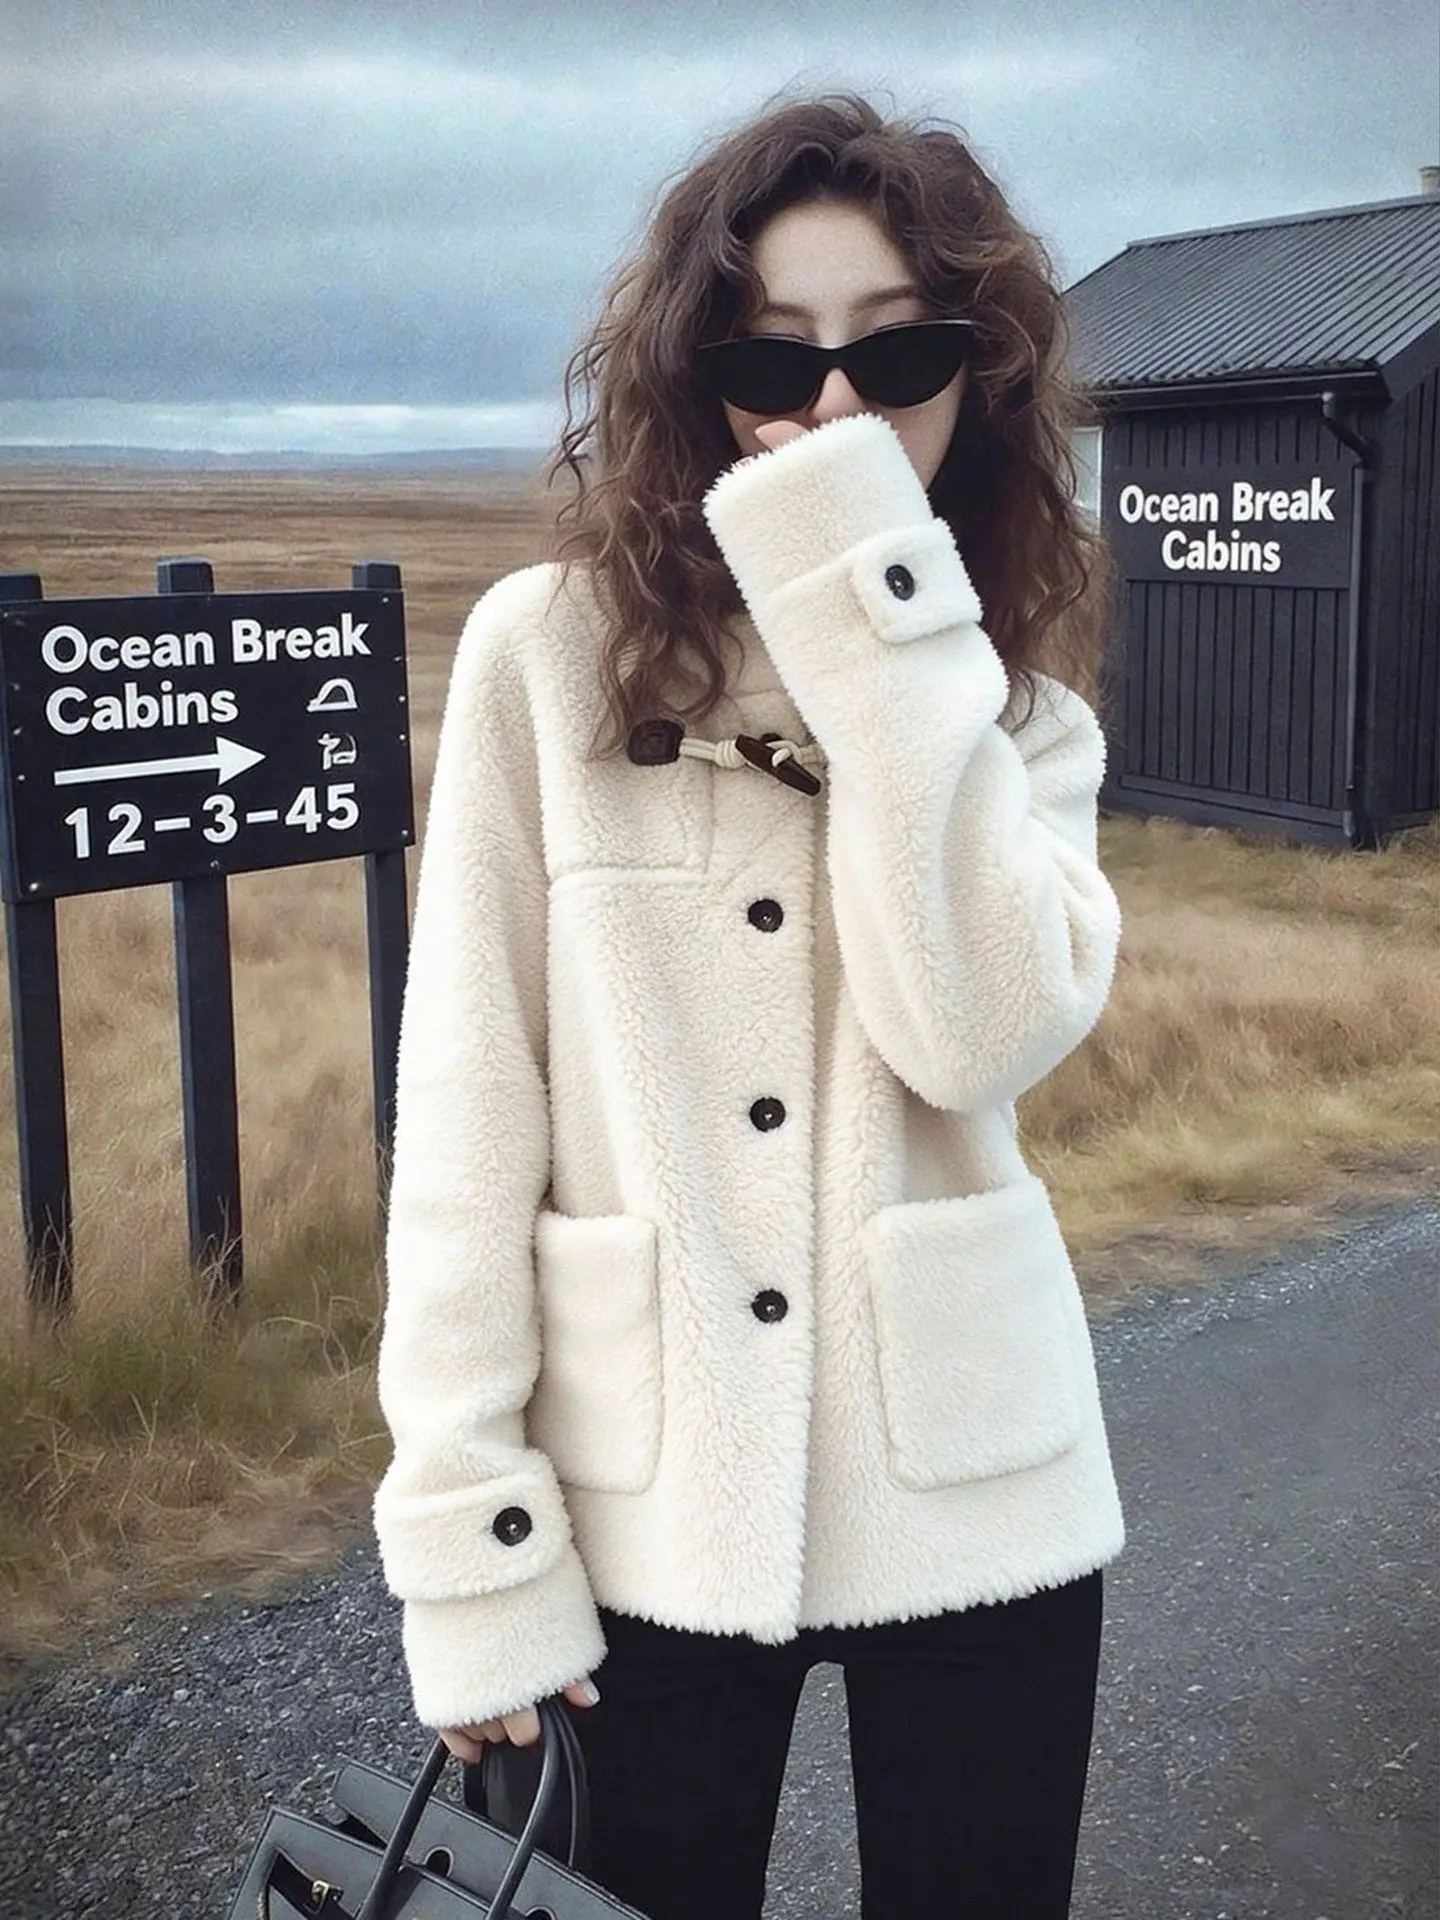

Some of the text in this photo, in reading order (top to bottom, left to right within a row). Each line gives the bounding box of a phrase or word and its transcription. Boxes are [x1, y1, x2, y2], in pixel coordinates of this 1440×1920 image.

[1119, 477, 1335, 524] Ocean Break
[1161, 528, 1281, 573] Cabins
[41, 612, 372, 673] Ocean Break
[46, 680, 239, 735] Cabins
